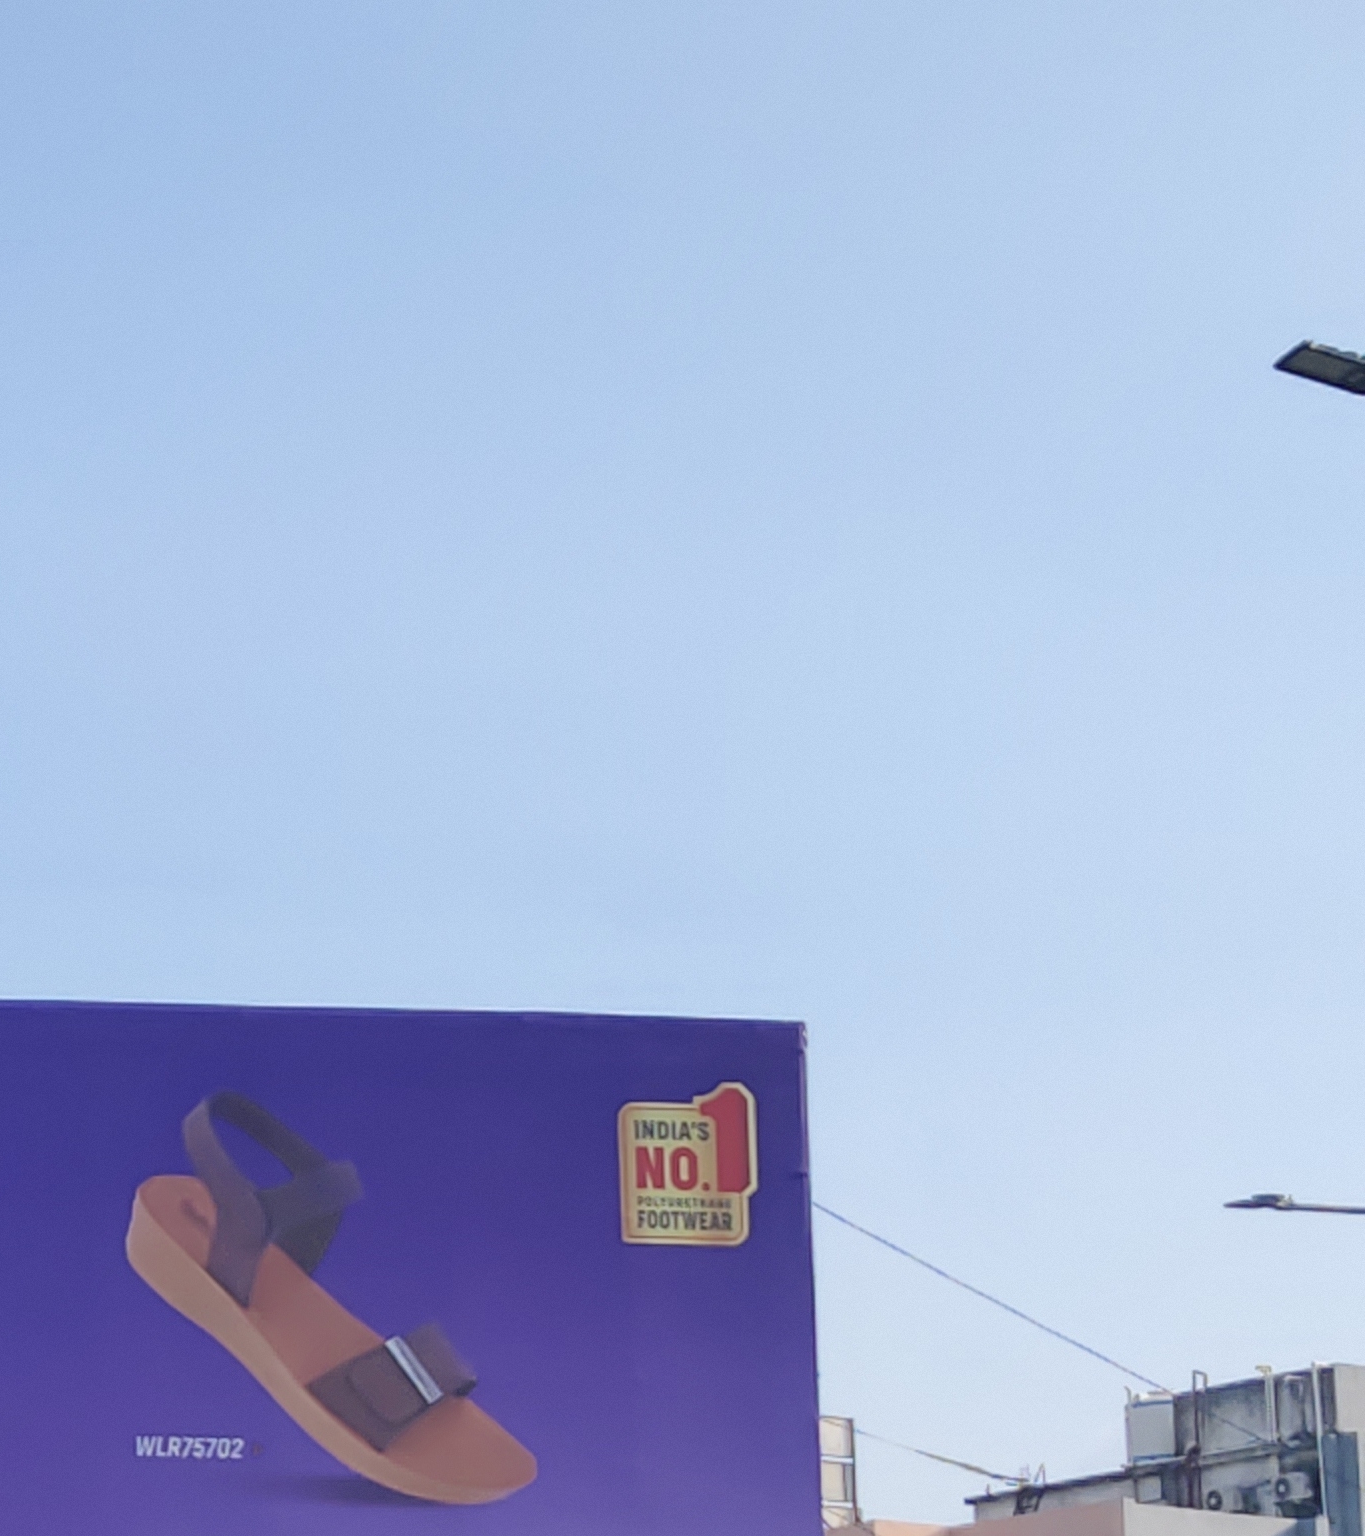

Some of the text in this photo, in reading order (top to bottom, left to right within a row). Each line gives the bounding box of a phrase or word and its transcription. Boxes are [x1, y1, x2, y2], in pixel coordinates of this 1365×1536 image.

[633, 1119, 710, 1141] INDIA'S
[634, 1145, 711, 1192] NO.
[636, 1209, 733, 1231] FOOTWEAR
[135, 1435, 246, 1459] WLR75702
